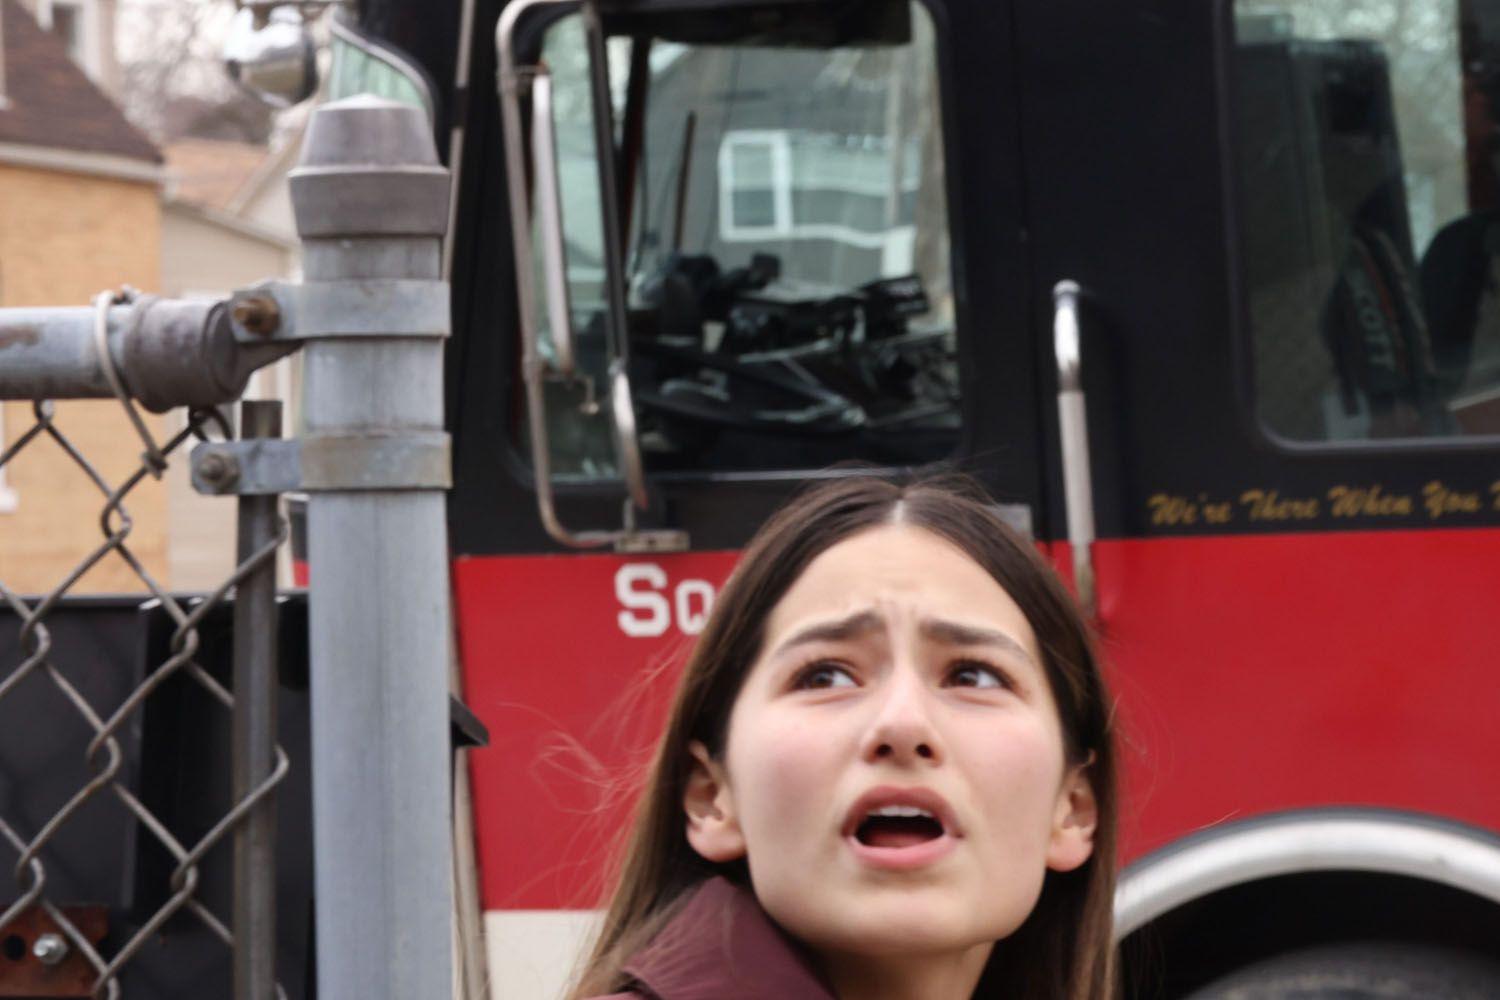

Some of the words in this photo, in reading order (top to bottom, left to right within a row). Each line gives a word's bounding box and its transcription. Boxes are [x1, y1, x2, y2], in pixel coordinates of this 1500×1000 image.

[1149, 491, 1231, 525] We're
[1239, 488, 1319, 521] There
[1326, 483, 1412, 518] When
[1422, 479, 1481, 520] You
